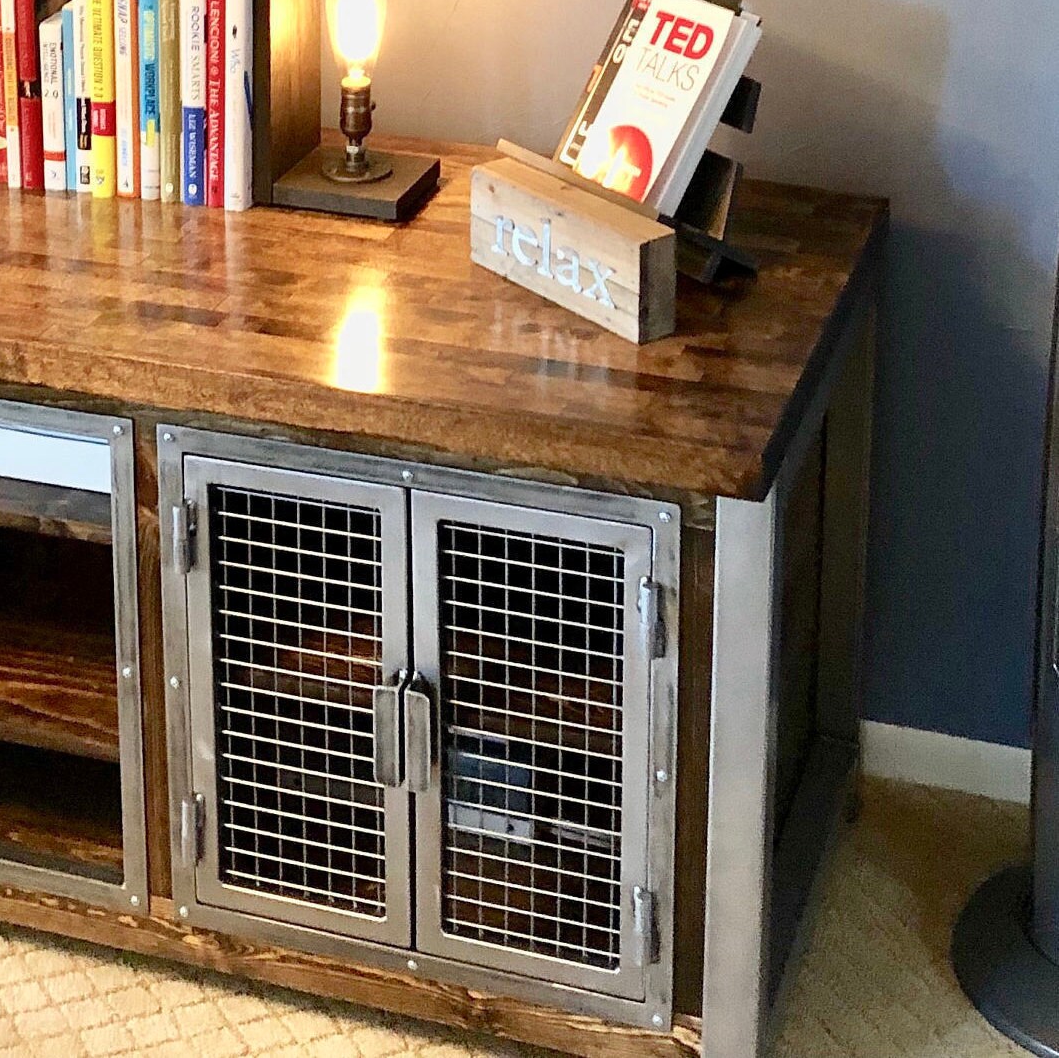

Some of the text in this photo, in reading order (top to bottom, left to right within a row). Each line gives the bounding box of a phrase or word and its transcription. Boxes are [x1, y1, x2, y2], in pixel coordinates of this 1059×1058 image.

[92, 7, 103, 44] ULTIMATE
[209, 0, 220, 64] LENCIONI
[648, 10, 714, 61] TED
[49, 42, 58, 84] EMOTIONAL
[93, 46, 103, 84] QUESTION
[191, 5, 200, 101] ROOKIE SMARTS
[635, 46, 701, 92] TALKS
[144, 63, 156, 115] WORKPLACE
[188, 114, 197, 178] LIZ WISEMAN
[208, 112, 220, 181] ADVANTAGE
[490, 215, 618, 309] relax
